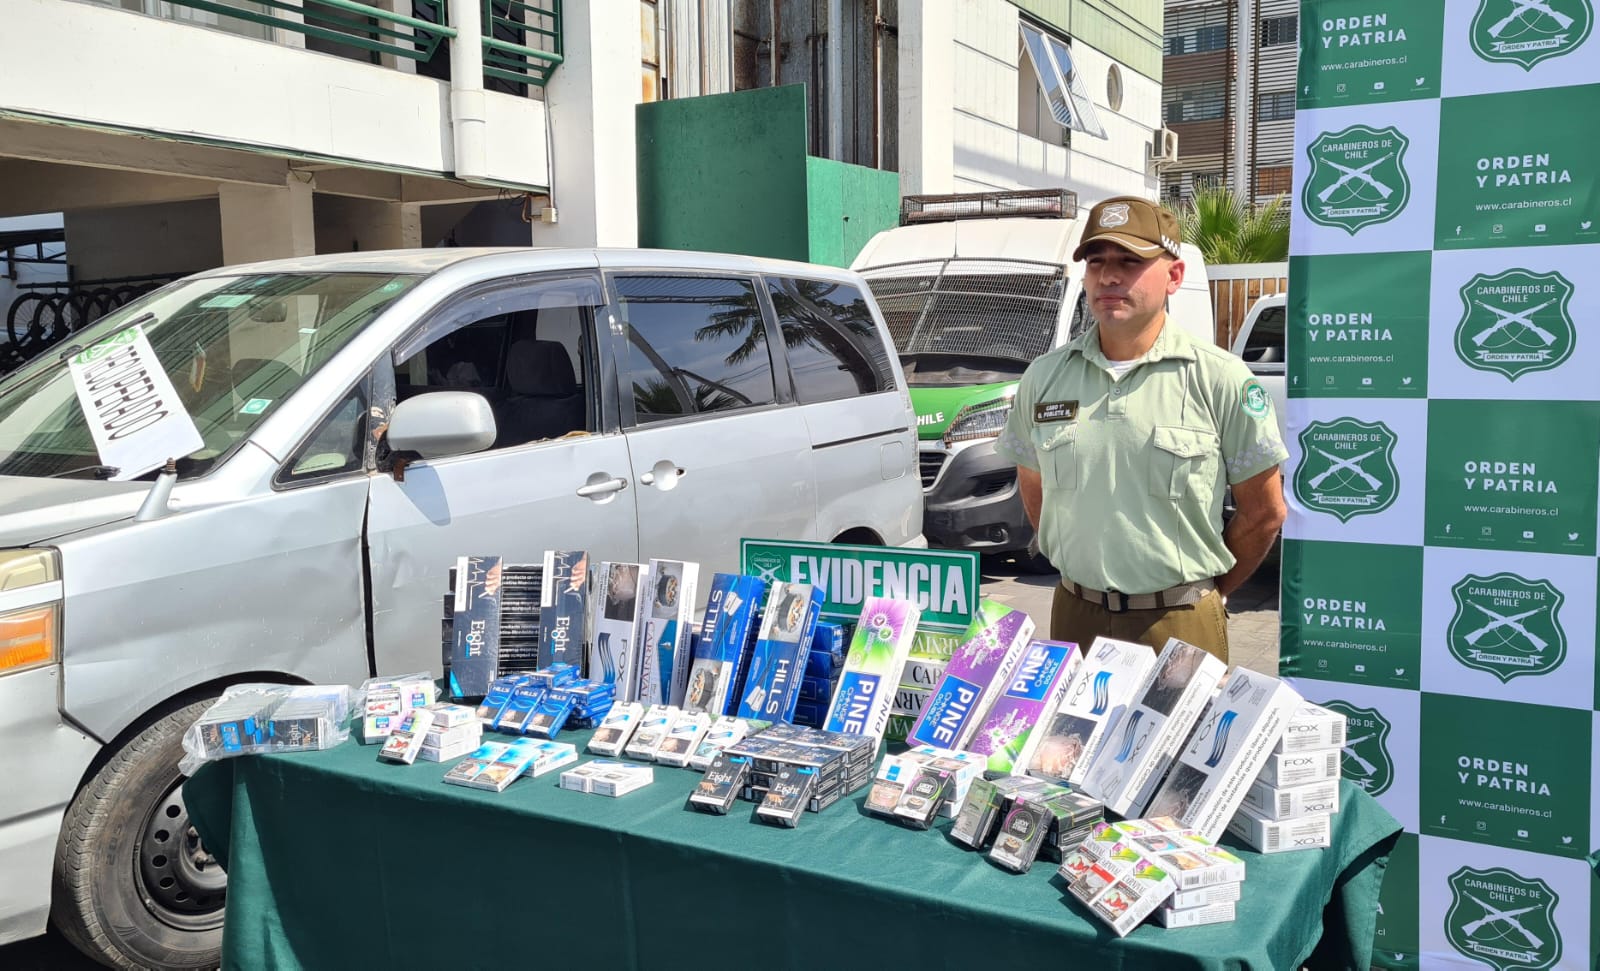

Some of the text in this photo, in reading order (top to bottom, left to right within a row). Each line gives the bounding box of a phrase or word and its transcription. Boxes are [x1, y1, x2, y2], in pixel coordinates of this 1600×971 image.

[1322, 14, 1388, 31] ORDEN
[1322, 29, 1406, 48] Y PATRIA
[1321, 56, 1407, 72] www.carabineros.cl
[1322, 139, 1392, 152] CARABINEROS DE
[1344, 150, 1368, 160] CHILE
[1477, 153, 1549, 170] ORDEN
[1476, 170, 1571, 188] Y PATRIA
[1476, 198, 1572, 210] www.carabineros.cl
[1477, 284, 1556, 295] CARABINEROS DE
[1502, 294, 1528, 302] CHILE
[1309, 312, 1372, 326] ORDEN
[1309, 329, 1392, 341] Y PATRIA
[1310, 354, 1394, 362] www.carabineros.cl
[82, 346, 168, 440] RECUPERADO
[917, 412, 944, 426] HILE
[1335, 441, 1358, 450] CHILE
[1464, 461, 1536, 475] ORDEN
[1464, 478, 1558, 493] Y PATRIA
[1464, 504, 1558, 516] www.carabineros.cl
[790, 555, 968, 615] EVIDENCIA
[1468, 587, 1531, 599] CARABINEROS
[1304, 598, 1366, 612] ORDEN
[1494, 598, 1520, 607] CHILE
[702, 590, 722, 642] HILLS
[1304, 614, 1386, 631] Y PATRIA
[466, 620, 485, 656] Eight
[552, 616, 570, 652] Eight
[1303, 639, 1386, 652] www.carabineros.cl
[617, 638, 627, 682] FOX
[1012, 643, 1050, 693] PINE
[766, 659, 789, 714] HILLS
[1070, 671, 1094, 707] FOX
[844, 680, 875, 734] PINE
[933, 688, 974, 744] PINE
[1288, 724, 1319, 733] FOX
[1364, 719, 1374, 728] DE
[1191, 712, 1221, 754] FOX
[1128, 722, 1155, 762] FOX
[1284, 757, 1313, 767] FOX
[1458, 756, 1528, 776] ORDEN
[708, 771, 732, 784] Eight
[1458, 772, 1551, 796] Y PATRIA
[775, 783, 800, 795] Eight
[1304, 803, 1334, 812] FOX
[1458, 798, 1552, 818] www.carabineros.cl
[1294, 836, 1324, 846] FOX
[1464, 878, 1541, 898] CARABINEROS DE
[1490, 891, 1515, 902] CHILE
